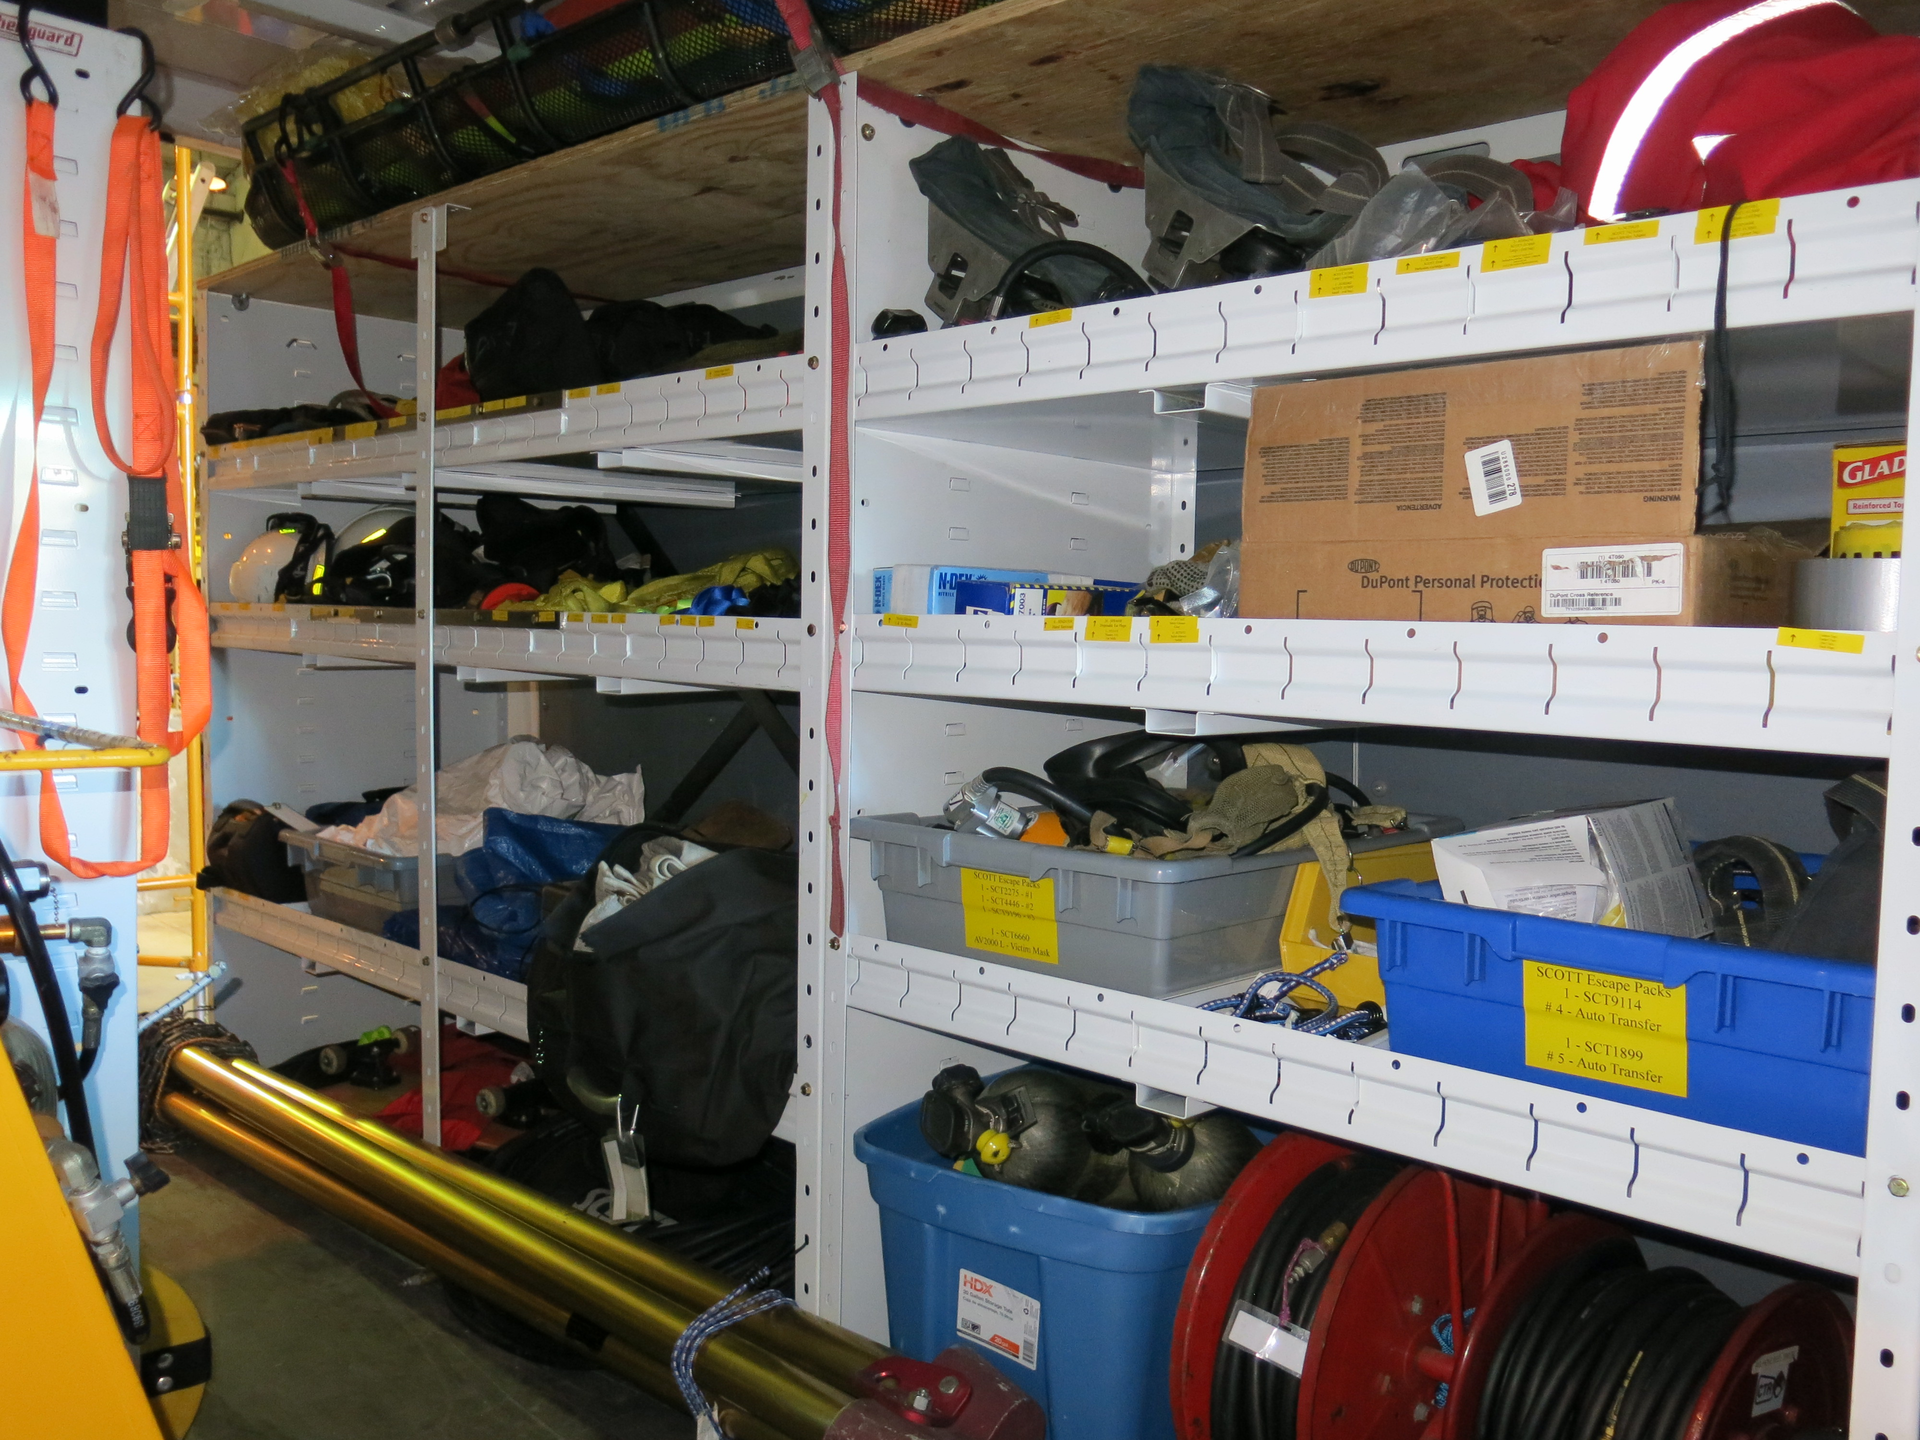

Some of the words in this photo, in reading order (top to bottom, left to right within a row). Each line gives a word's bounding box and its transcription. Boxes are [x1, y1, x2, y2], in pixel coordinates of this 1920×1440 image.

[1842, 455, 1907, 484] GLAD
[1506, 482, 1518, 497] 278
[1643, 494, 1681, 503] WARNING
[1395, 503, 1443, 511] ADVERTENCIA
[1852, 501, 1892, 510] Reinforced
[1360, 575, 1410, 589] DuPont
[1413, 574, 1476, 589] Personal
[874, 575, 882, 608] N-DEX
[973, 871, 997, 883] SCOTT
[998, 876, 1020, 887] Escape
[1021, 879, 1041, 889] Packs
[990, 885, 1020, 897] SCT2275
[990, 896, 1020, 909] SCT4446
[1000, 930, 1030, 941] SCT6660
[974, 936, 999, 946] AV2000
[1010, 942, 1031, 953] Victim
[1032, 947, 1051, 957] Mask
[1536, 965, 1584, 984] SCOTT
[1587, 974, 1631, 993] Escape
[1634, 981, 1672, 998] Packs
[1583, 991, 1642, 1011] SCT9114
[1545, 1001, 1552, 1012] #
[1556, 1004, 1563, 1015] 4
[1575, 1008, 1606, 1023] Auto
[1609, 1012, 1662, 1032] Transfer
[1584, 1041, 1644, 1061] SCT1899
[1547, 1051, 1554, 1062] #
[1557, 1053, 1565, 1064] 5
[1576, 1058, 1607, 1073] Auto
[1610, 1063, 1664, 1084] Transfer
[963, 1274, 994, 1298] HDX
[985, 1297, 1003, 1310] Storage
